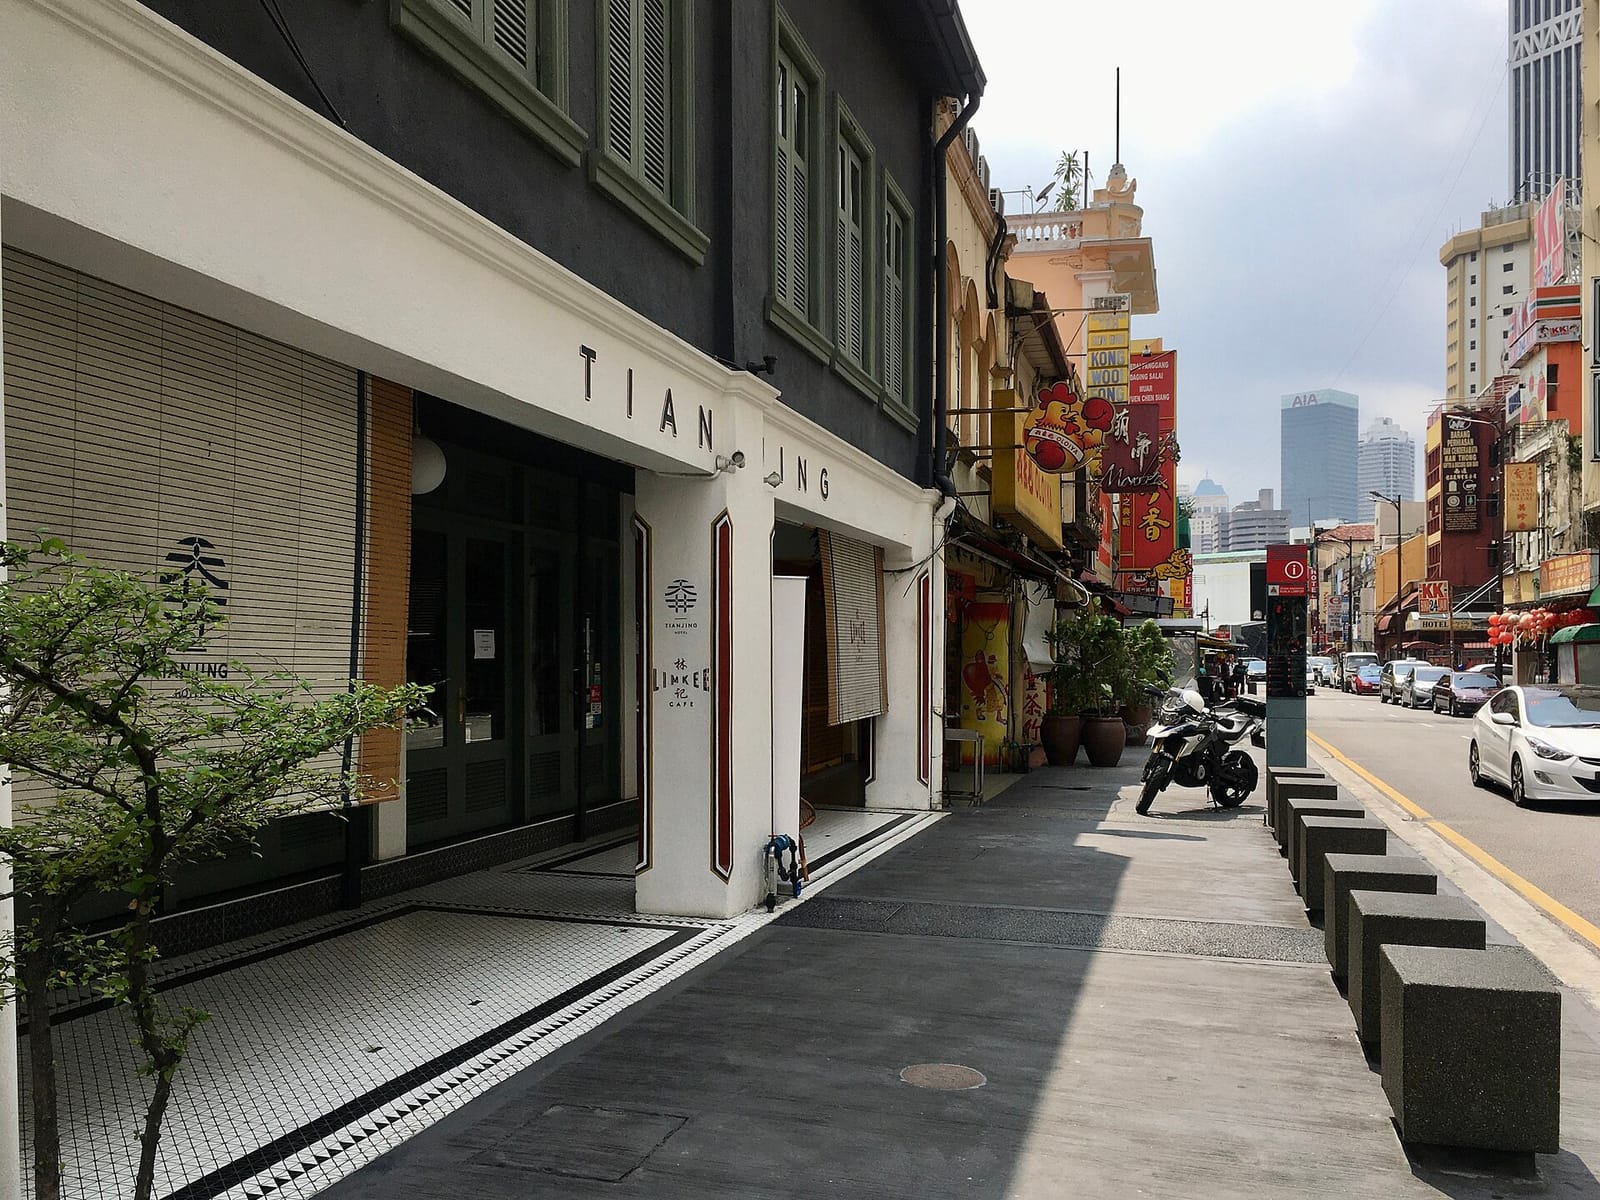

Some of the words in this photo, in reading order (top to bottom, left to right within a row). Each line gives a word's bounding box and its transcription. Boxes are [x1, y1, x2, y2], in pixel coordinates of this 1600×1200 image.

[1091, 351, 1124, 368] KONG
[1091, 369, 1125, 385] WOOI
[1292, 393, 1318, 407] AIA
[1422, 582, 1444, 598] KK
[1422, 620, 1449, 628] HOTEL
